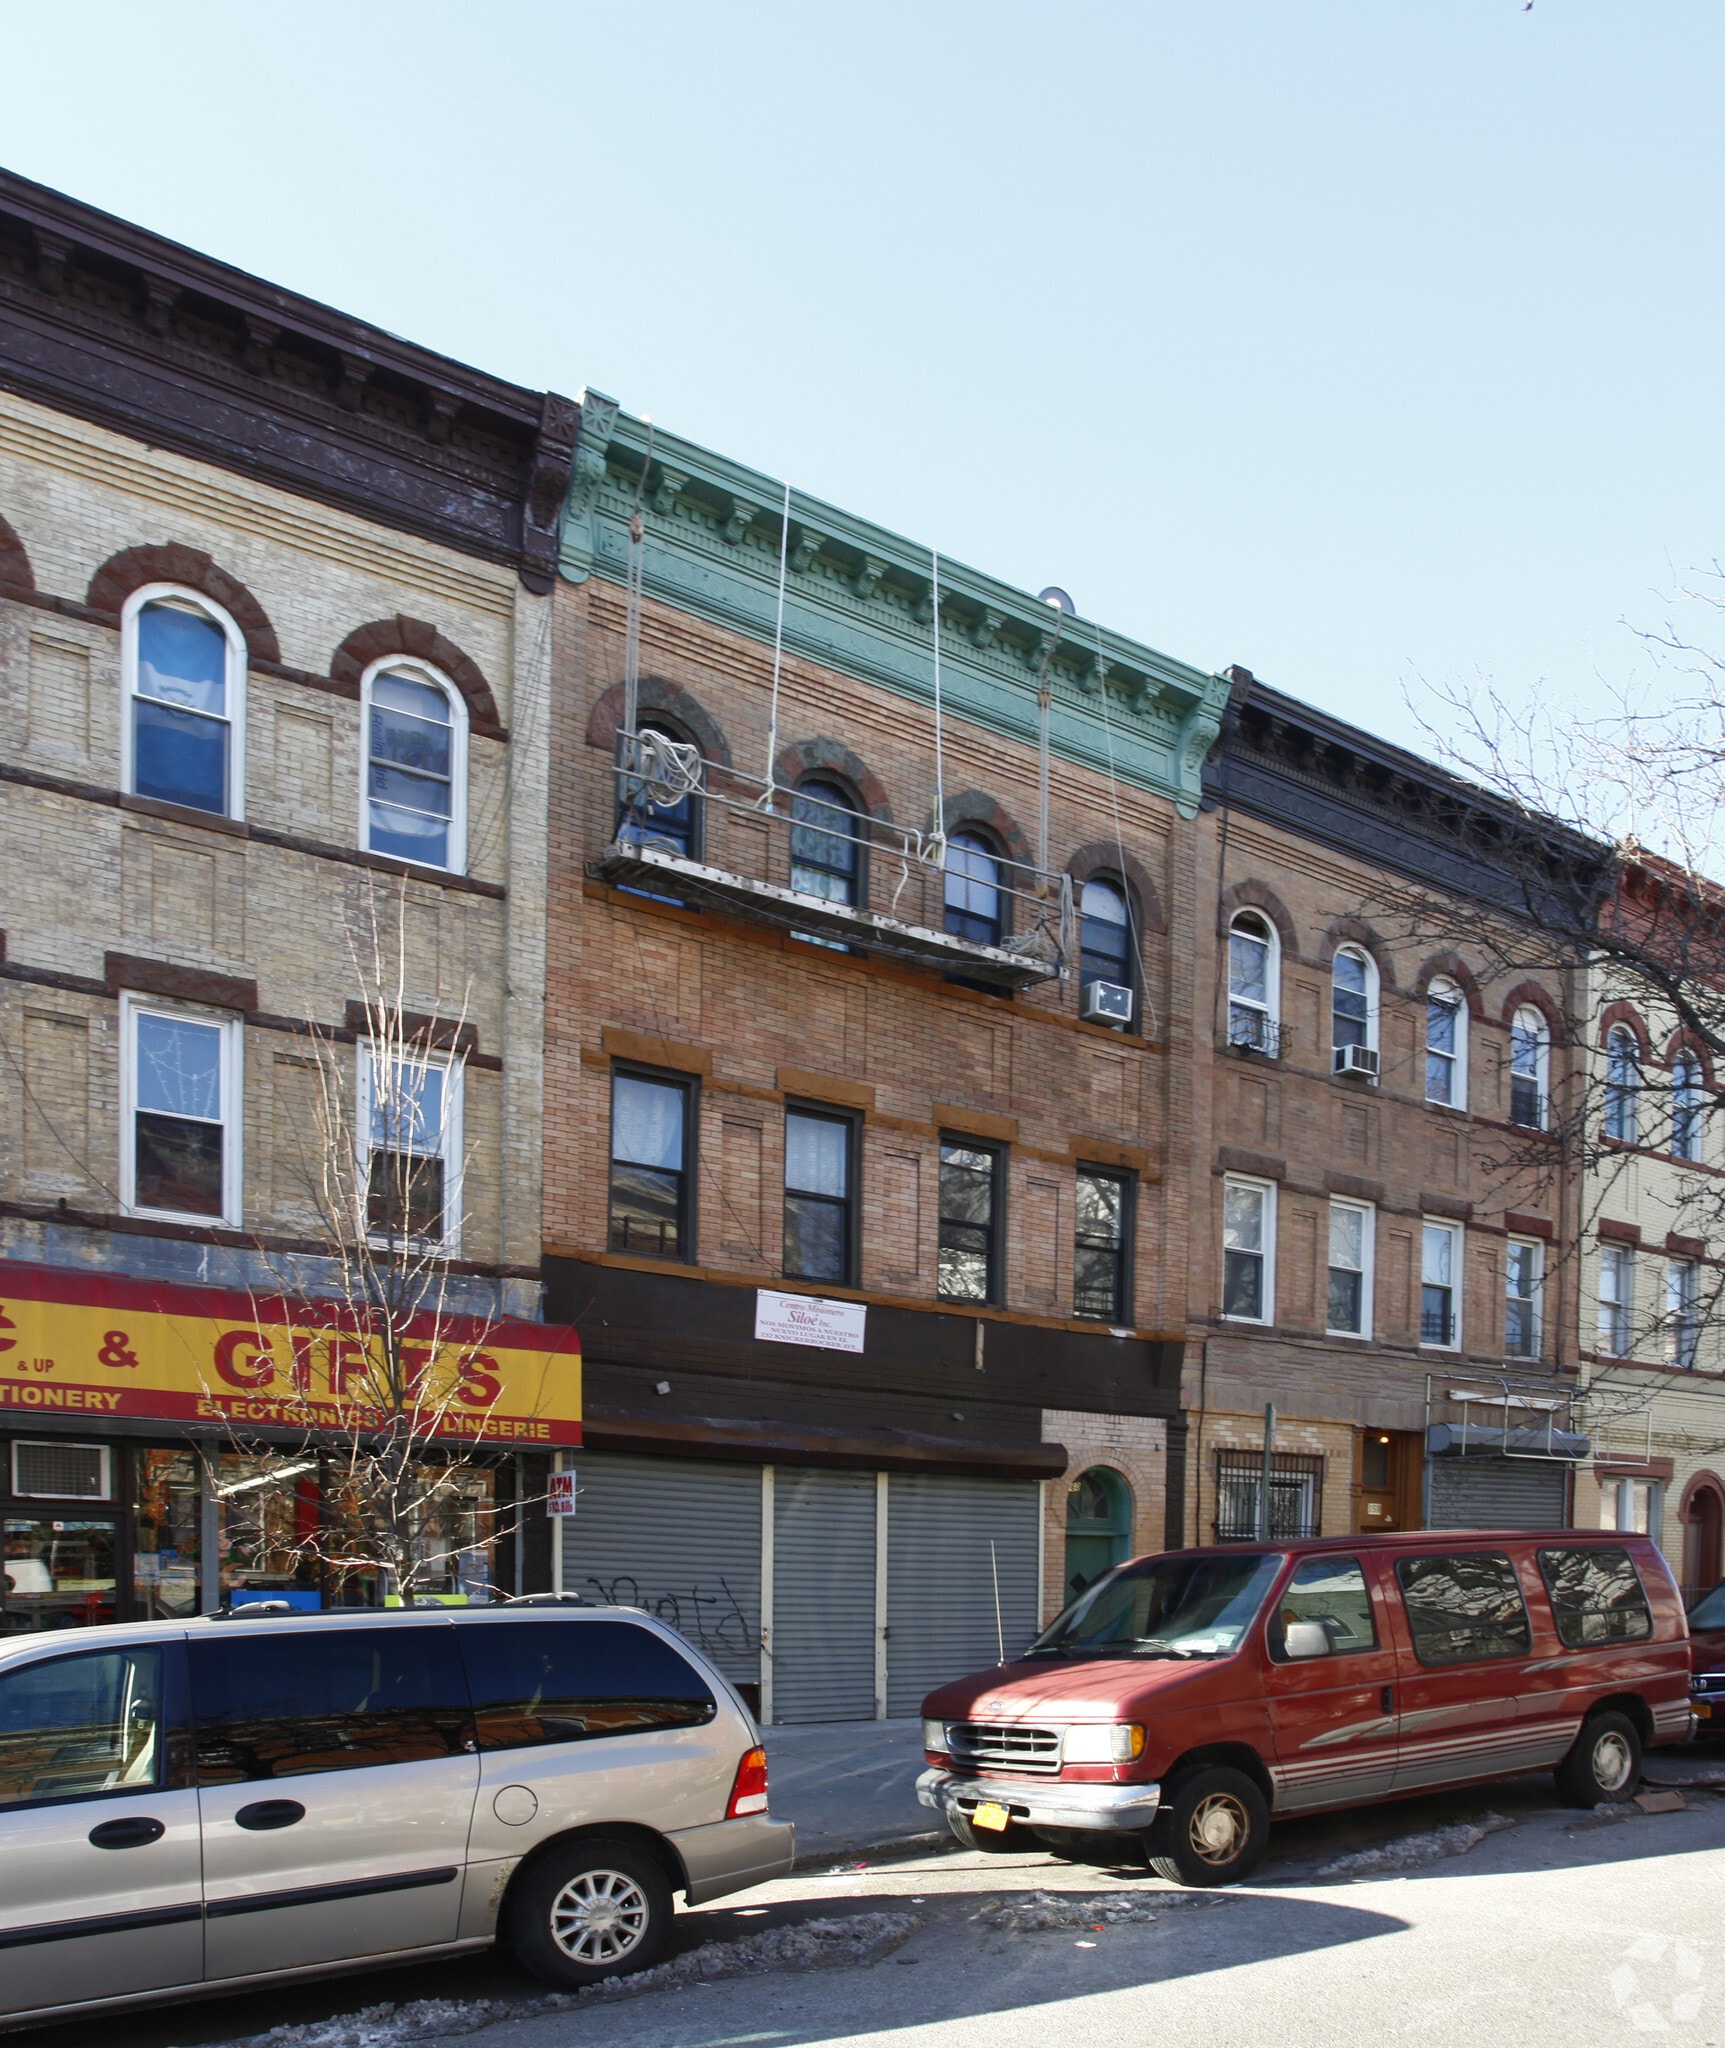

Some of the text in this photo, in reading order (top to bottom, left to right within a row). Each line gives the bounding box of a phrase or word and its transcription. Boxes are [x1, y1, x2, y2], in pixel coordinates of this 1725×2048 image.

[779, 1300, 806, 1310] Centro
[33, 1358, 54, 1373] UP
[98, 1329, 502, 1408] & GIFTS
[196, 1399, 379, 1429] ELECTRONICS
[443, 1416, 551, 1439] LINGERIE
[550, 1476, 572, 1499] ATM
